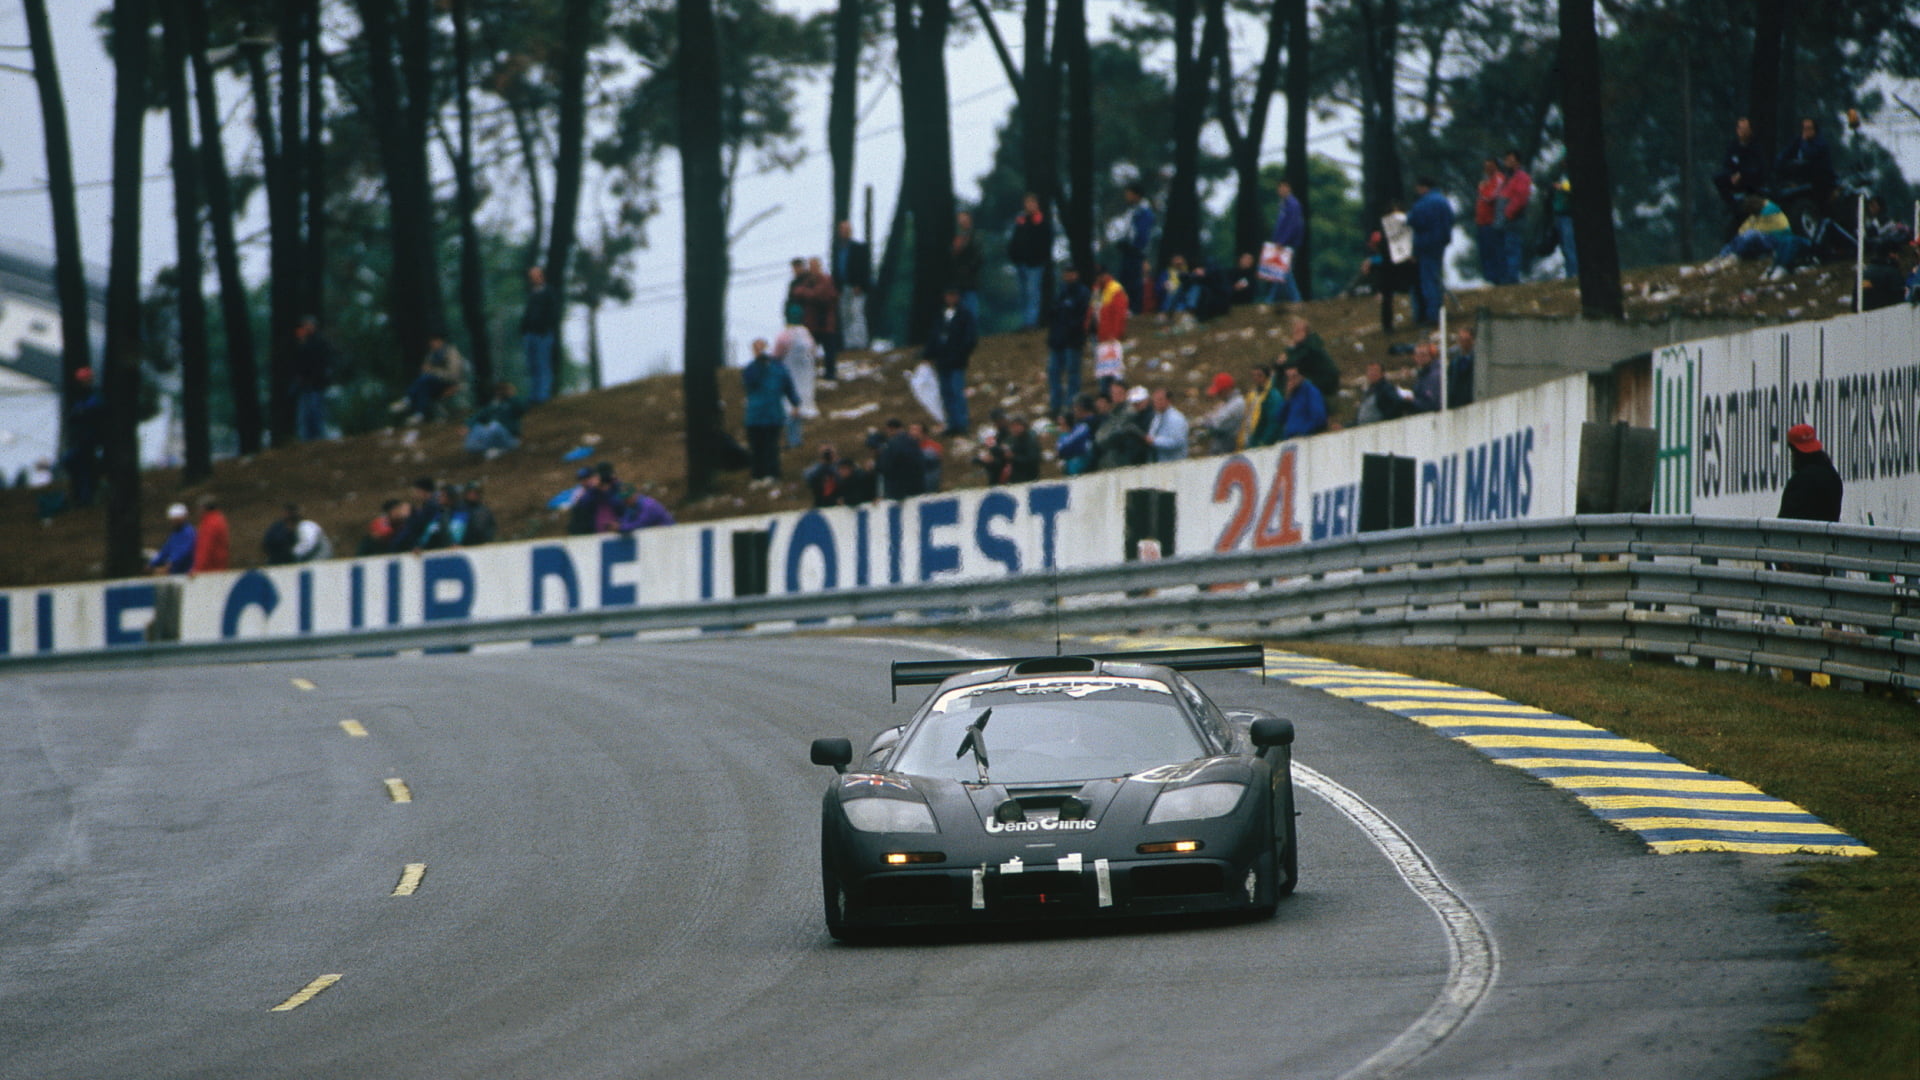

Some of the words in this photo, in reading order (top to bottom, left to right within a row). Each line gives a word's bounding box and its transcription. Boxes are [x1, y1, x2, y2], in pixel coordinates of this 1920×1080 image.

[1213, 443, 1301, 554] 24
[1421, 452, 1459, 527] DU
[1463, 425, 1534, 523] MANS
[1696, 346, 1722, 498] les
